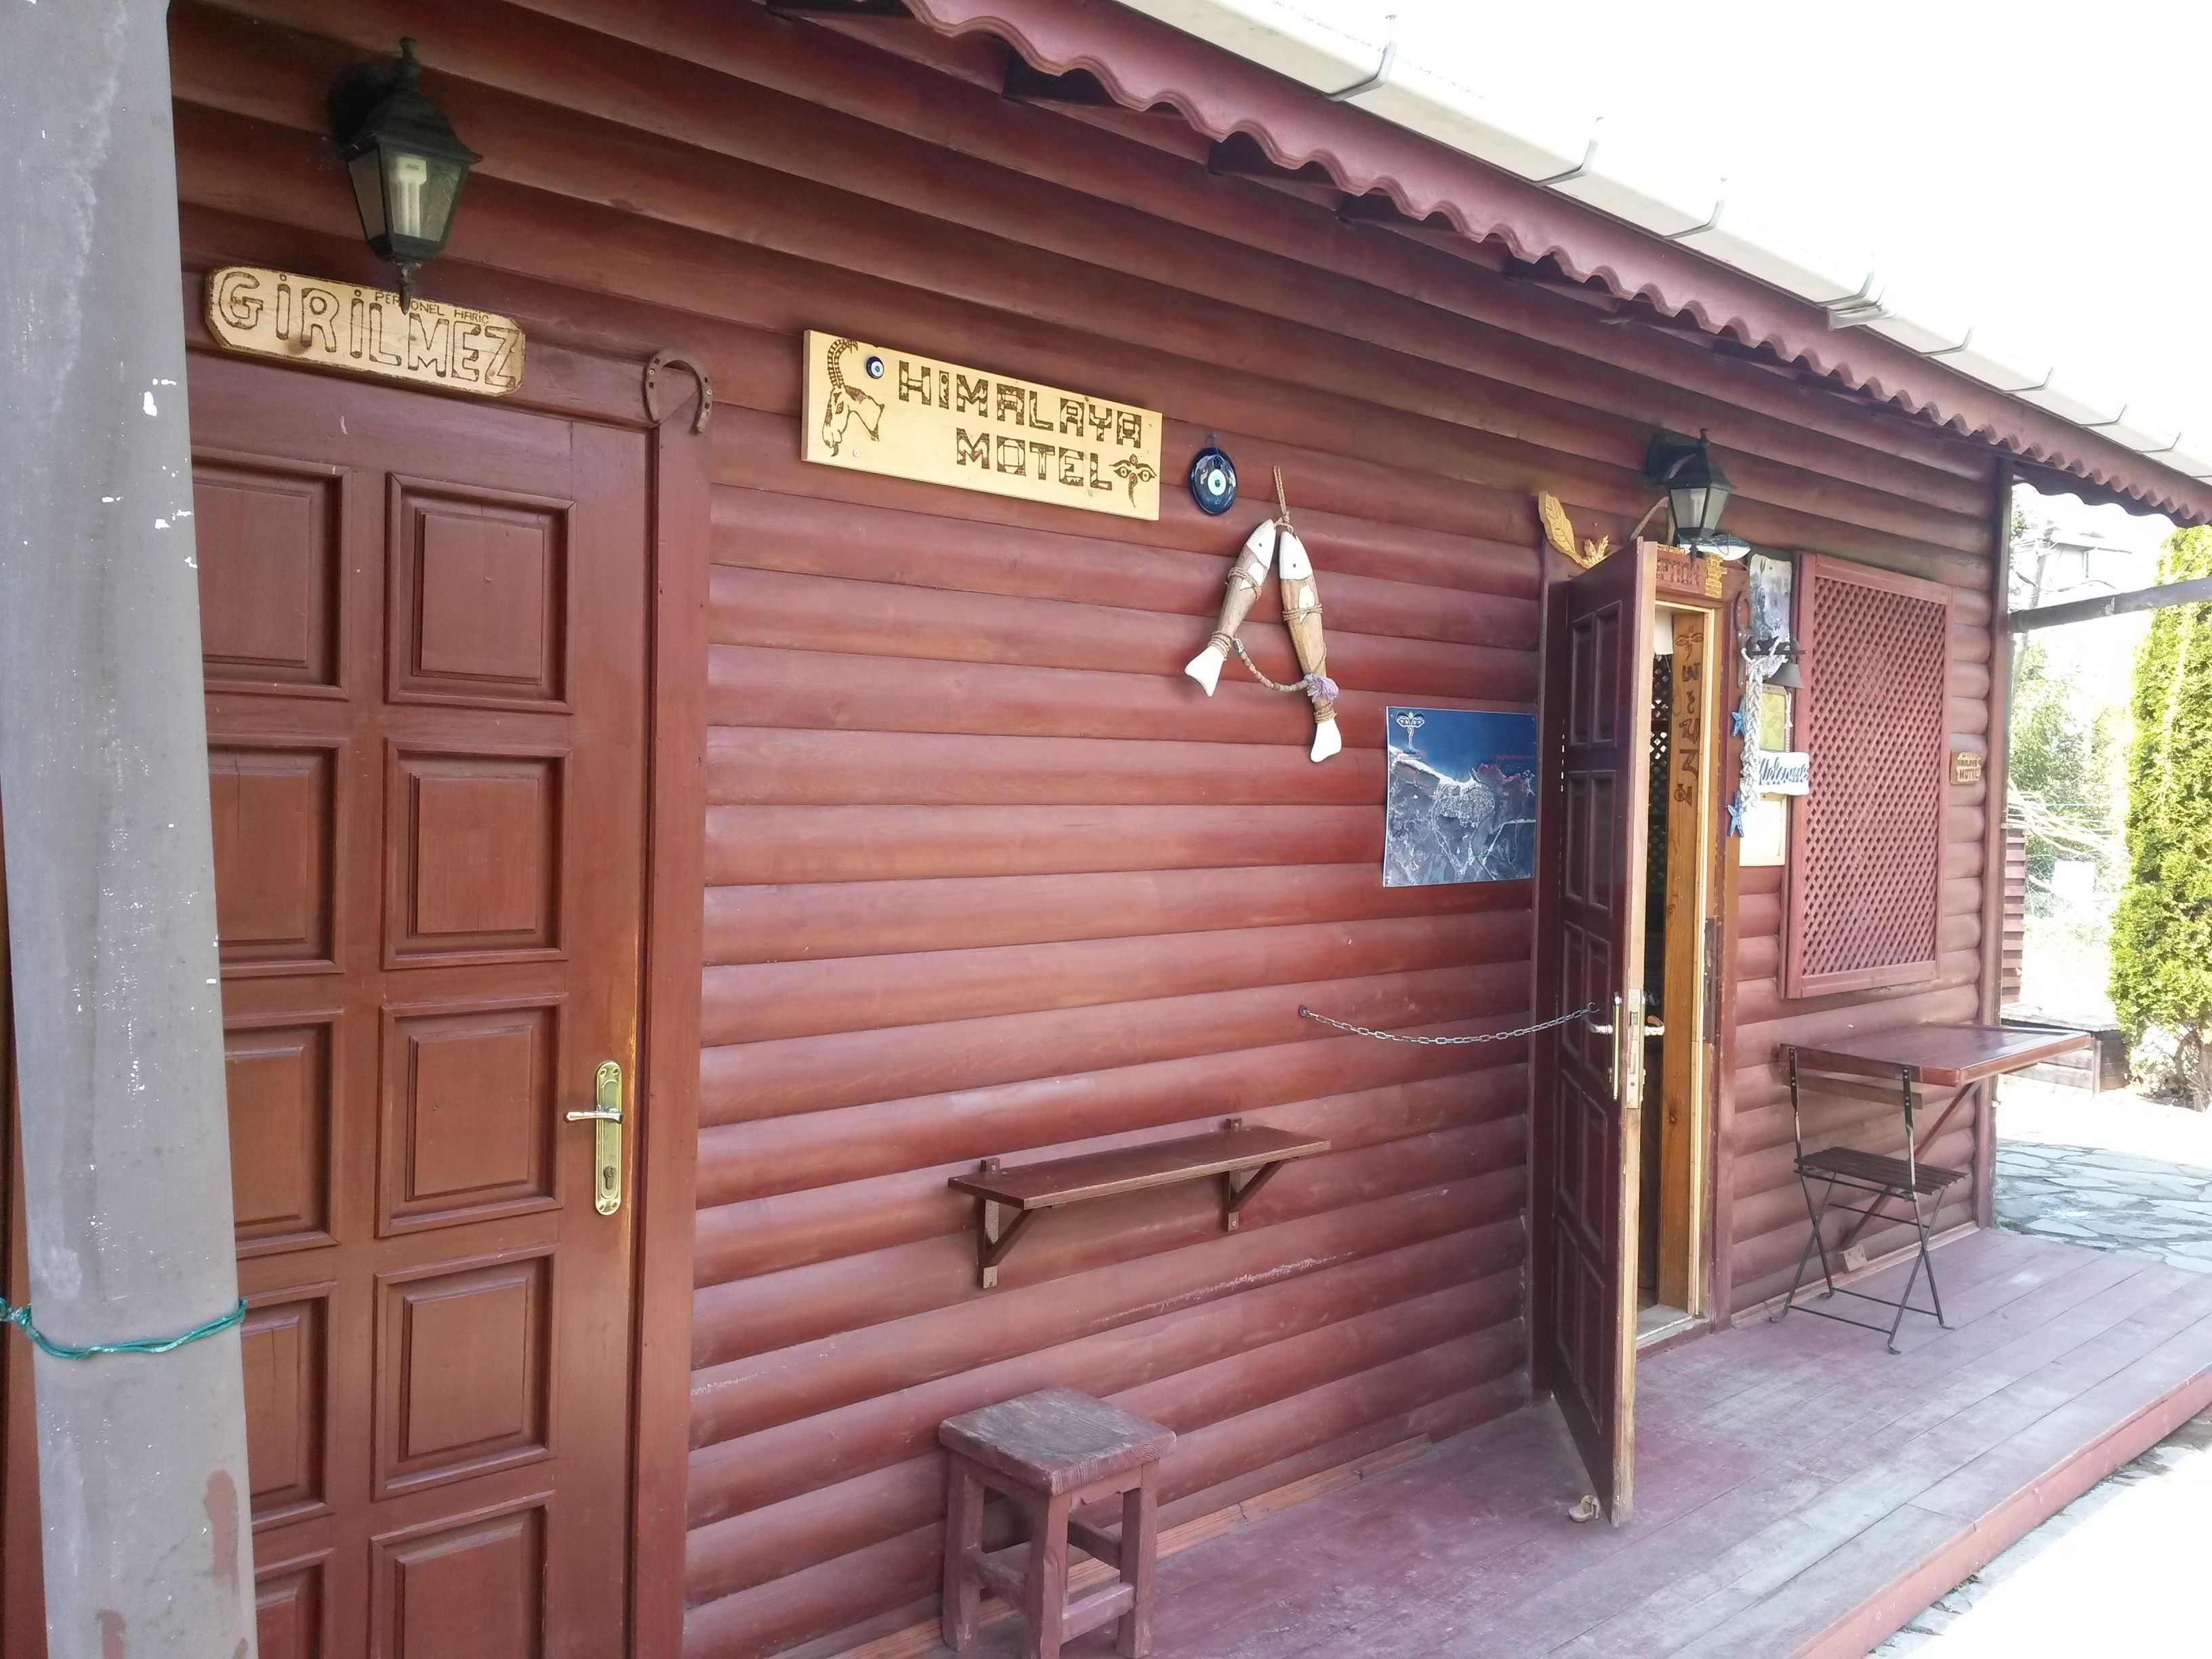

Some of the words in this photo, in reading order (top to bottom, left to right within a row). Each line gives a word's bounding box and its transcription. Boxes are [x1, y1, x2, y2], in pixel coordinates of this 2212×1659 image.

[375, 291, 445, 316] PERONEL
[898, 360, 1142, 449] HIMALAYA
[956, 427, 1113, 491] MOTEL
